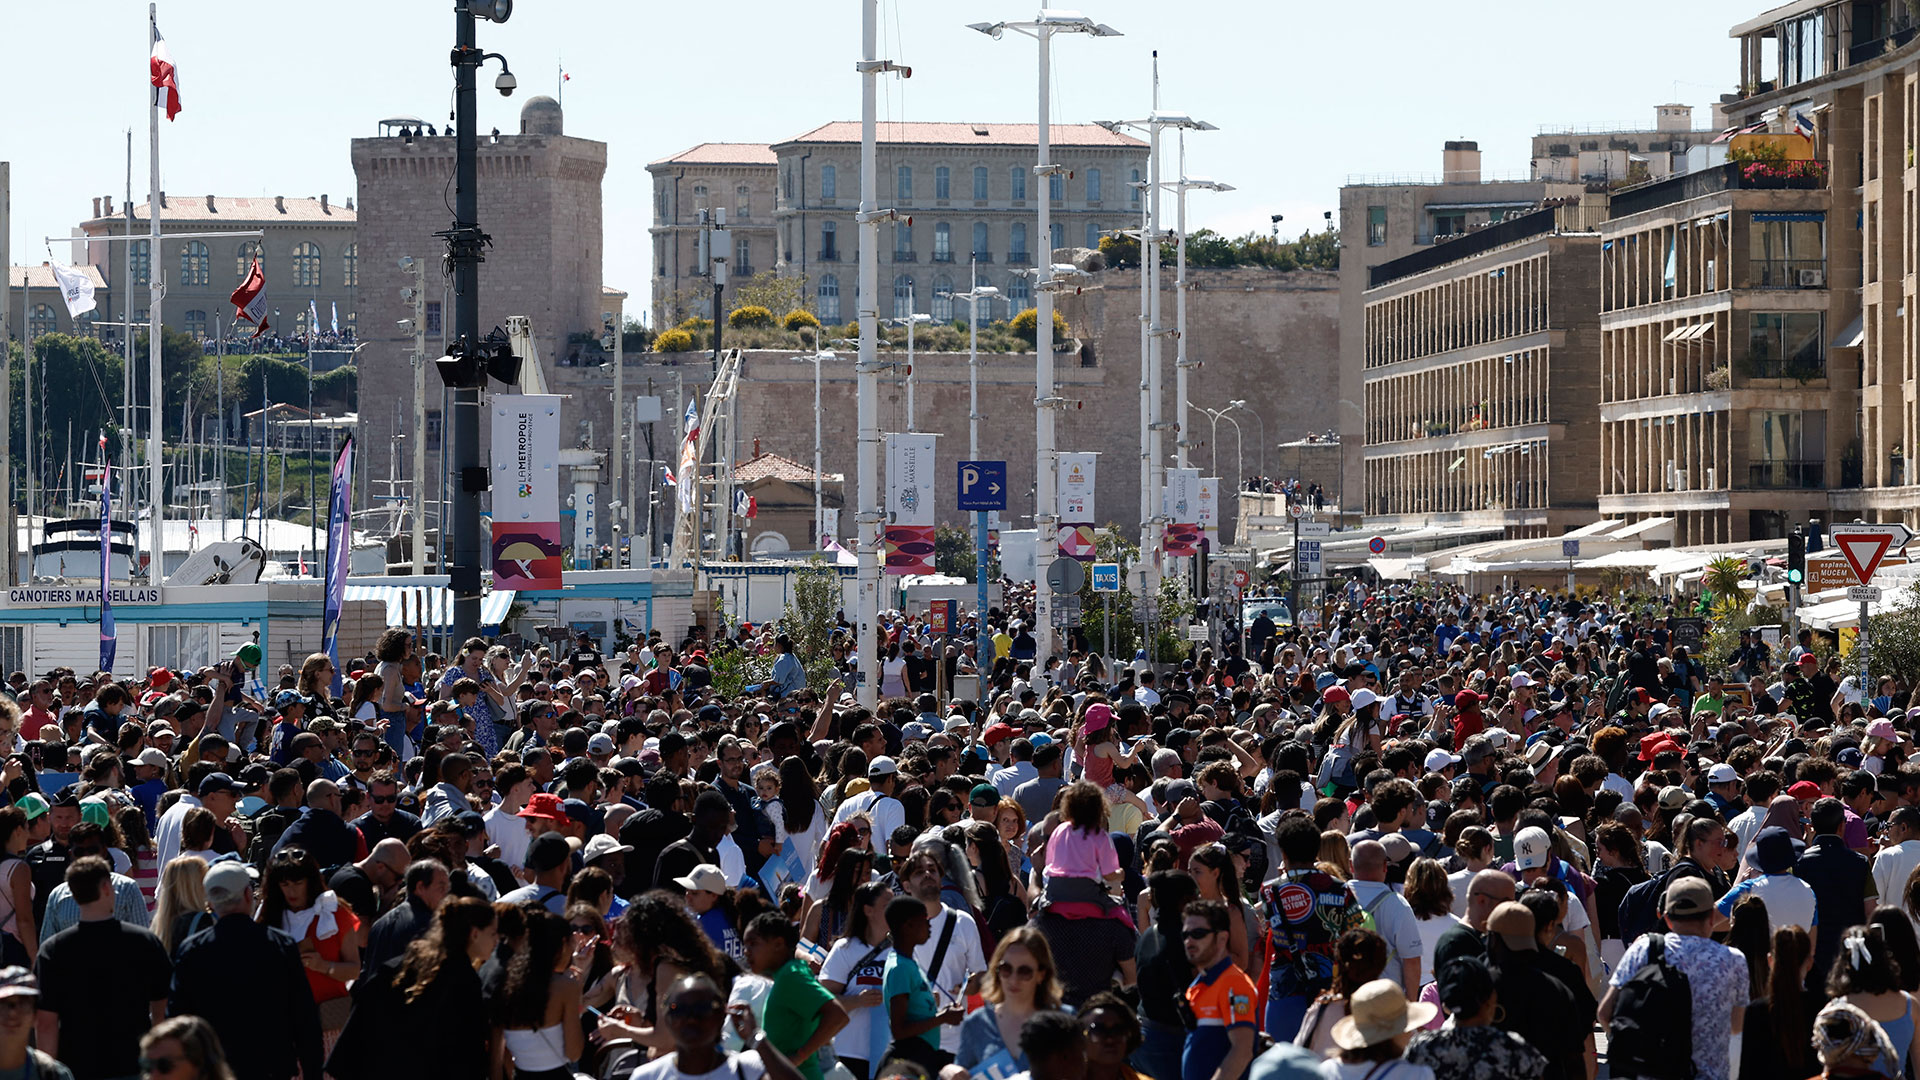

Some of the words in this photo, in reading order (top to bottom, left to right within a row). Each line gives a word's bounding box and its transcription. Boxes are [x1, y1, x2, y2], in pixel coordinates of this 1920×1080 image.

[963, 469, 979, 494] P
[1095, 573, 1117, 583] TAXIS
[11, 590, 72, 602] CANOTIERS
[1320, 893, 1345, 905] DALLA
